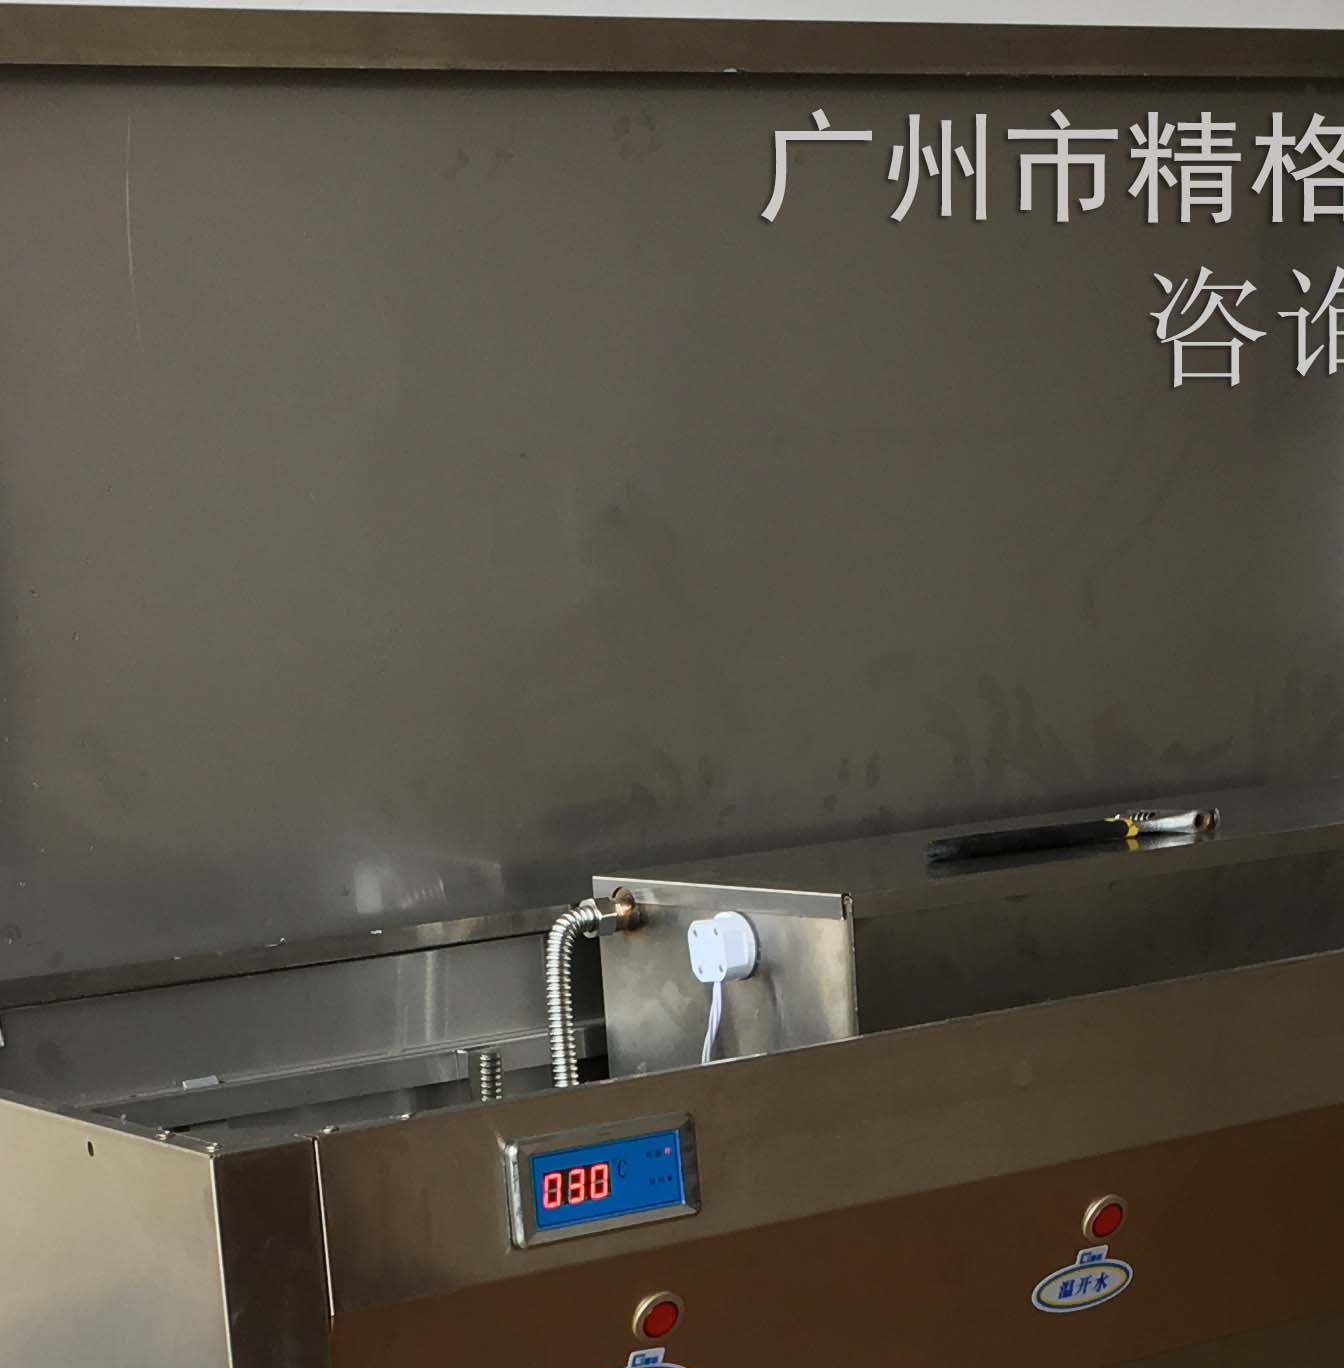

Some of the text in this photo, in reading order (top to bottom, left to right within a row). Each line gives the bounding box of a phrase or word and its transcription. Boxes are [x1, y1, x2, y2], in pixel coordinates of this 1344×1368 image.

[541, 1161, 610, 1211] 030
[1058, 1271, 1110, 1300] 温开水
